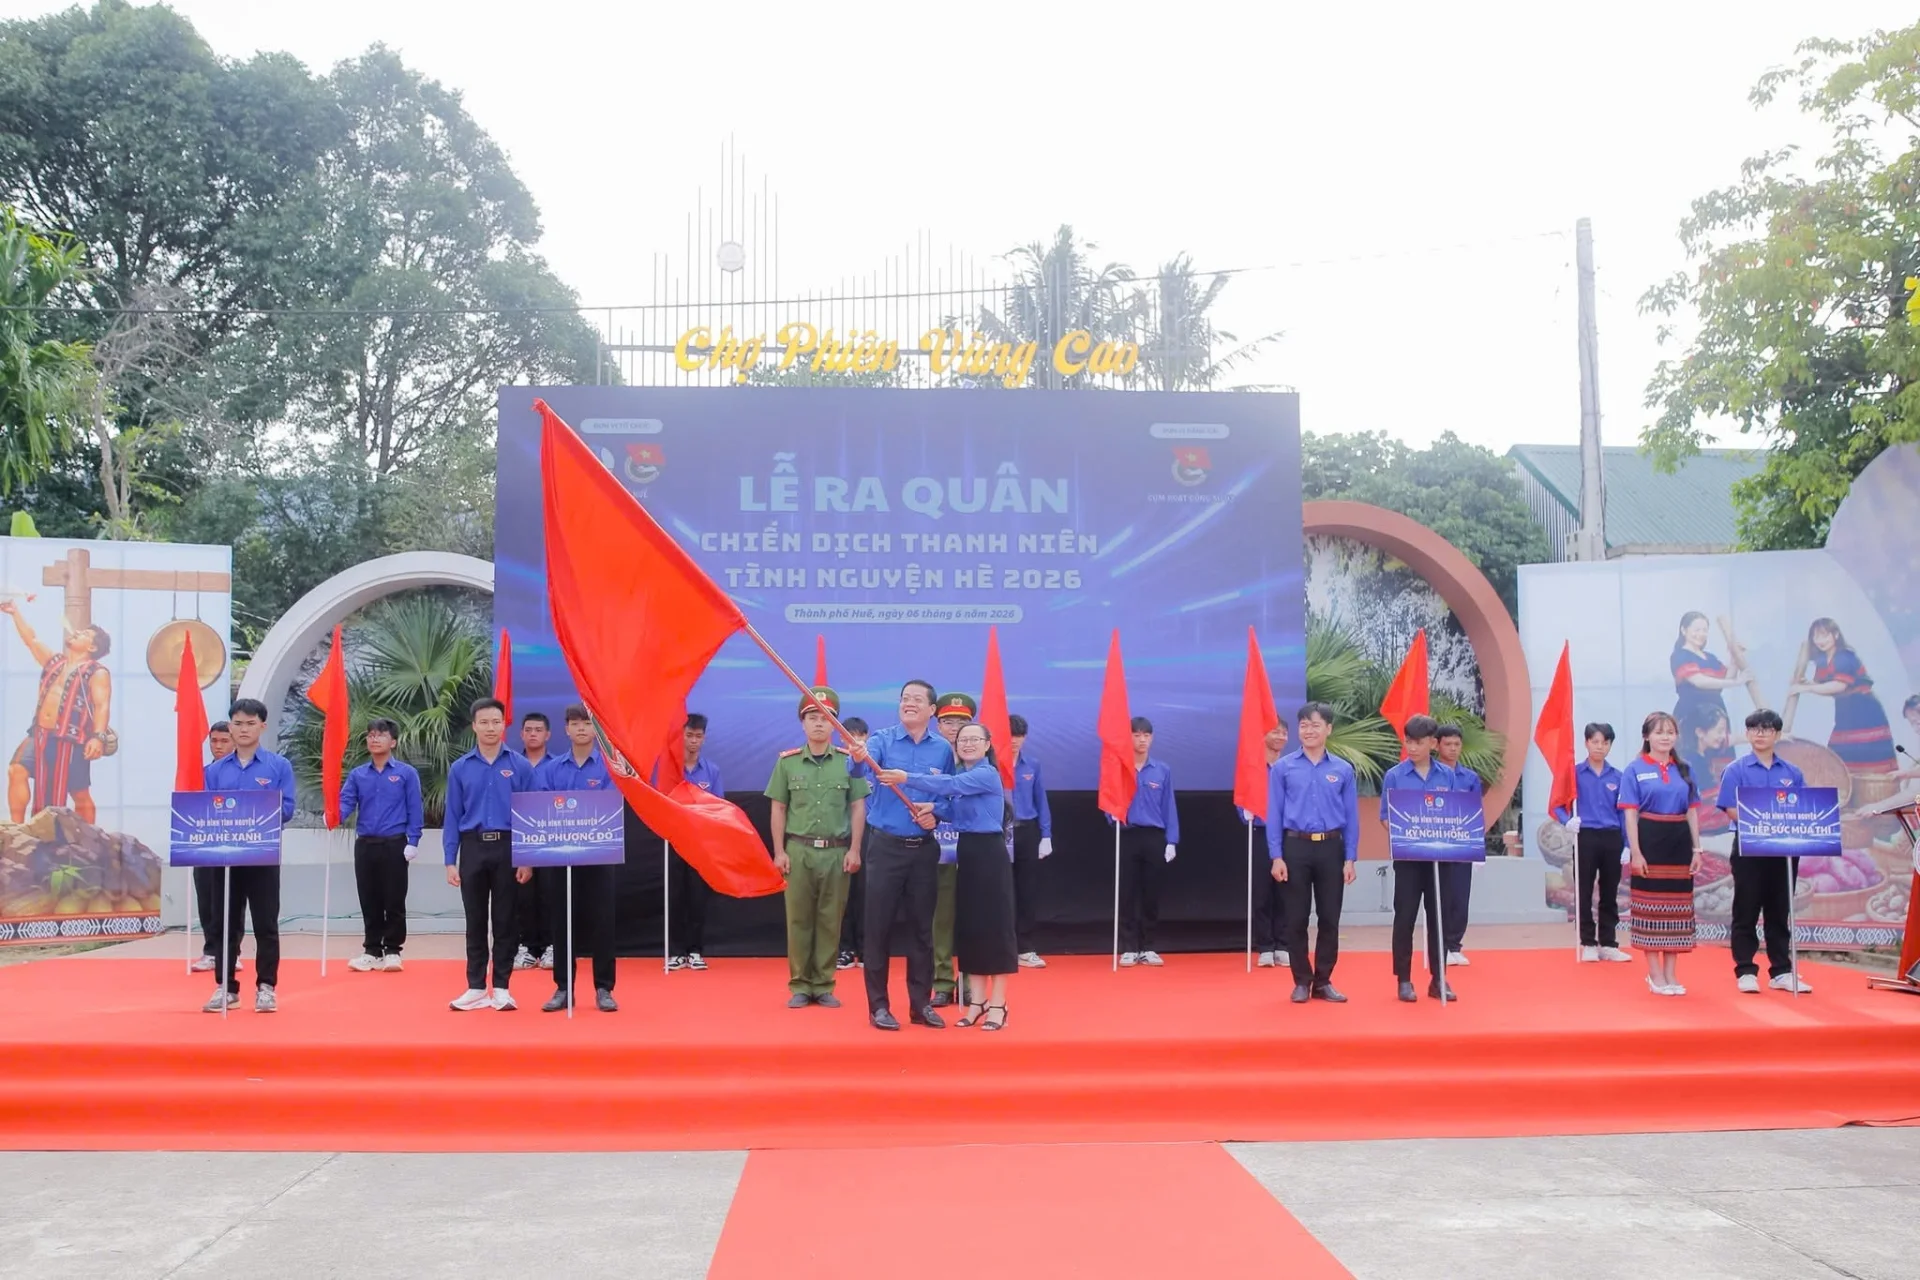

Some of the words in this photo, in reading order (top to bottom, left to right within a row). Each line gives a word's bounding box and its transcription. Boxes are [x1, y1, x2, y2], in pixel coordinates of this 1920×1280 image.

[674, 325, 766, 384] Chợ
[777, 322, 900, 373] Phiên
[921, 328, 1037, 388] Vùng
[1052, 329, 1139, 376] Cao
[739, 451, 799, 512] LỄ
[815, 477, 890, 513] RA
[902, 461, 1069, 520] QUÂN
[701, 520, 801, 553] CHIẾN
[812, 532, 891, 558] DỊCH
[901, 533, 1008, 554] THANH
[1018, 528, 1098, 555] NIÊN
[725, 562, 806, 588] TÌNH
[817, 562, 943, 594] NGUYỆN
[954, 563, 993, 588] HÈ
[1003, 569, 1082, 589] 2026
[793, 607, 826, 619] Thành
[829, 607, 849, 621] phố
[851, 606, 875, 620] Huế,
[878, 609, 904, 621] ngày
[906, 609, 920, 619] 06
[921, 608, 954, 622] tháng
[954, 609, 962, 619] 6
[964, 608, 988, 619] năm
[990, 609, 1015, 619] 2026
[216, 829, 230, 842] HÈ
[232, 832, 262, 841] XANH
[522, 833, 547, 843] HOA
[548, 832, 595, 844] PHƯỢNG
[1749, 821, 1771, 834] TIẾP
[1771, 823, 1790, 834] SỨC
[1791, 823, 1813, 834] MÙA
[1814, 826, 1831, 834] THI
